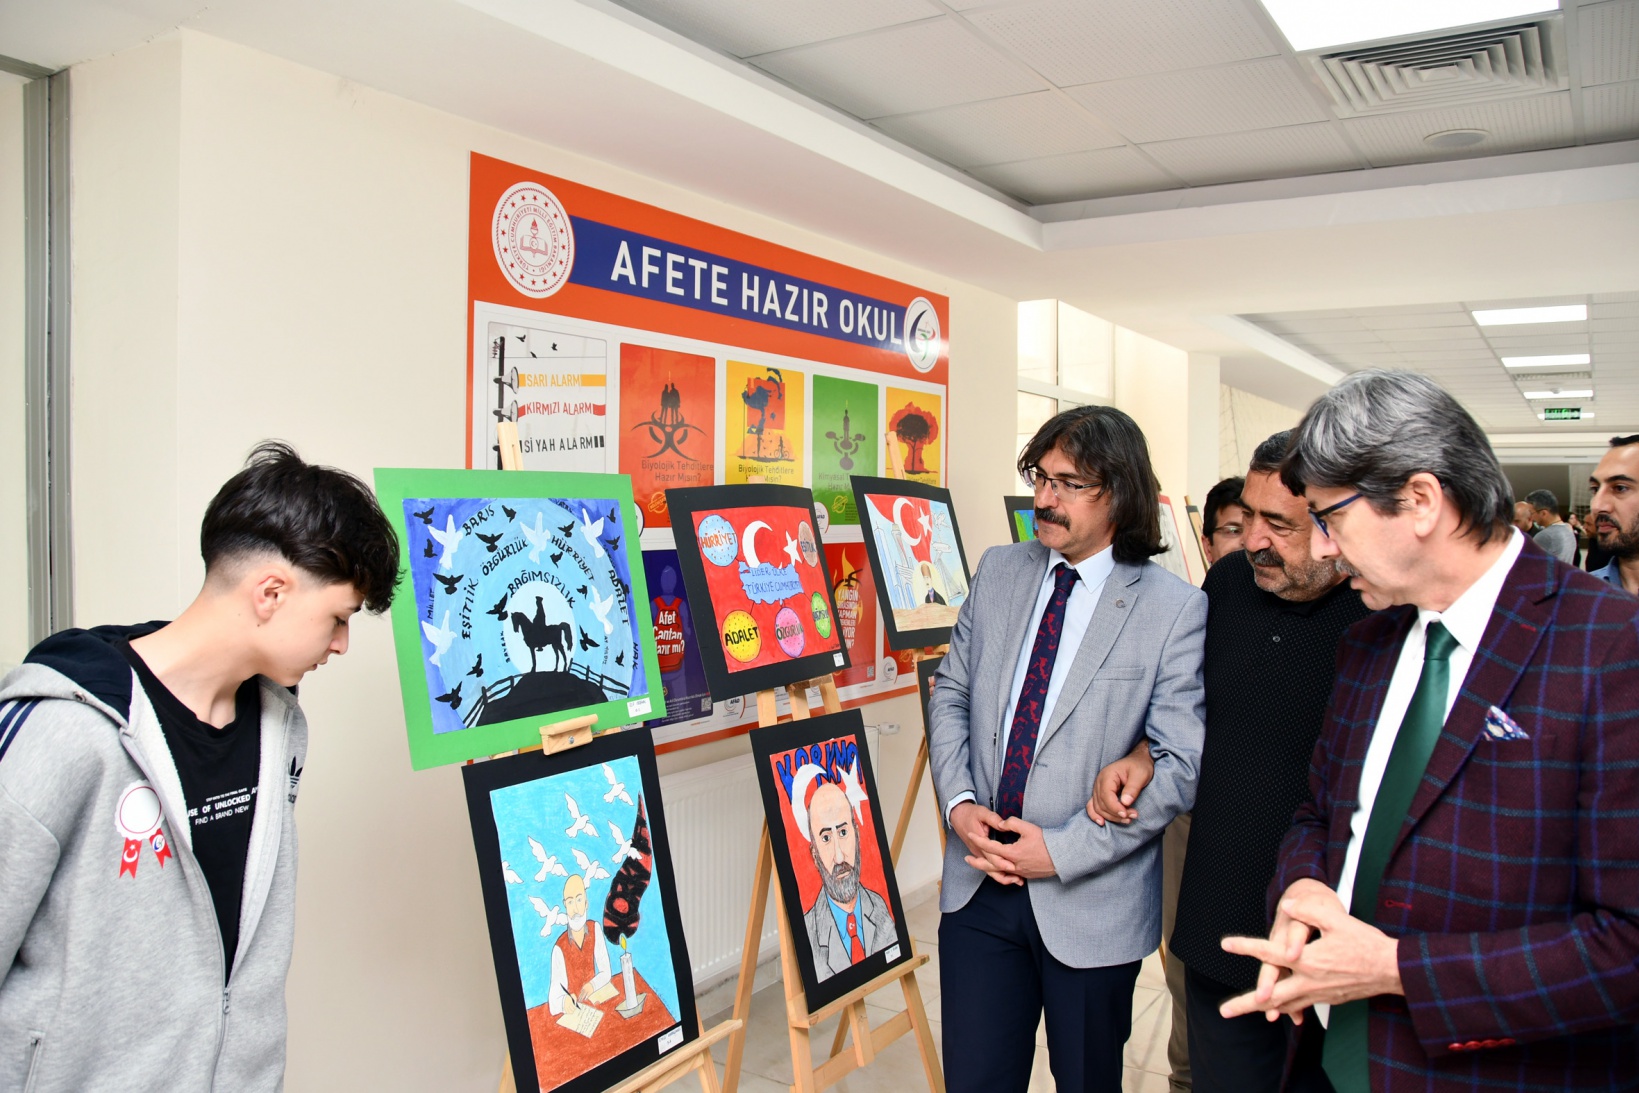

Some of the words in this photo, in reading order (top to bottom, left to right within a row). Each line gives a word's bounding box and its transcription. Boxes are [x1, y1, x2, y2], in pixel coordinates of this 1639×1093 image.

[610, 240, 728, 306] AFETE
[742, 272, 828, 329] HAZIR
[839, 299, 902, 345] OKUL
[526, 374, 548, 387] SARI
[551, 374, 580, 387] ALARM
[526, 402, 560, 415] KIRMIZI
[563, 402, 592, 415] ALARM
[642, 460, 674, 471] Biyolojik
[677, 461, 714, 471] Tehditlere
[738, 464, 763, 474] Biyolojik
[655, 473, 675, 481] Hazır
[659, 611, 676, 625] Afet
[725, 626, 759, 646] ADALET
[655, 640, 670, 654] azır
[202, 805, 211, 814] OF
[214, 794, 251, 810] UNLOCKED
[195, 816, 208, 825] FIND
[216, 809, 233, 820] BRAND
[235, 805, 250, 814] NEW
